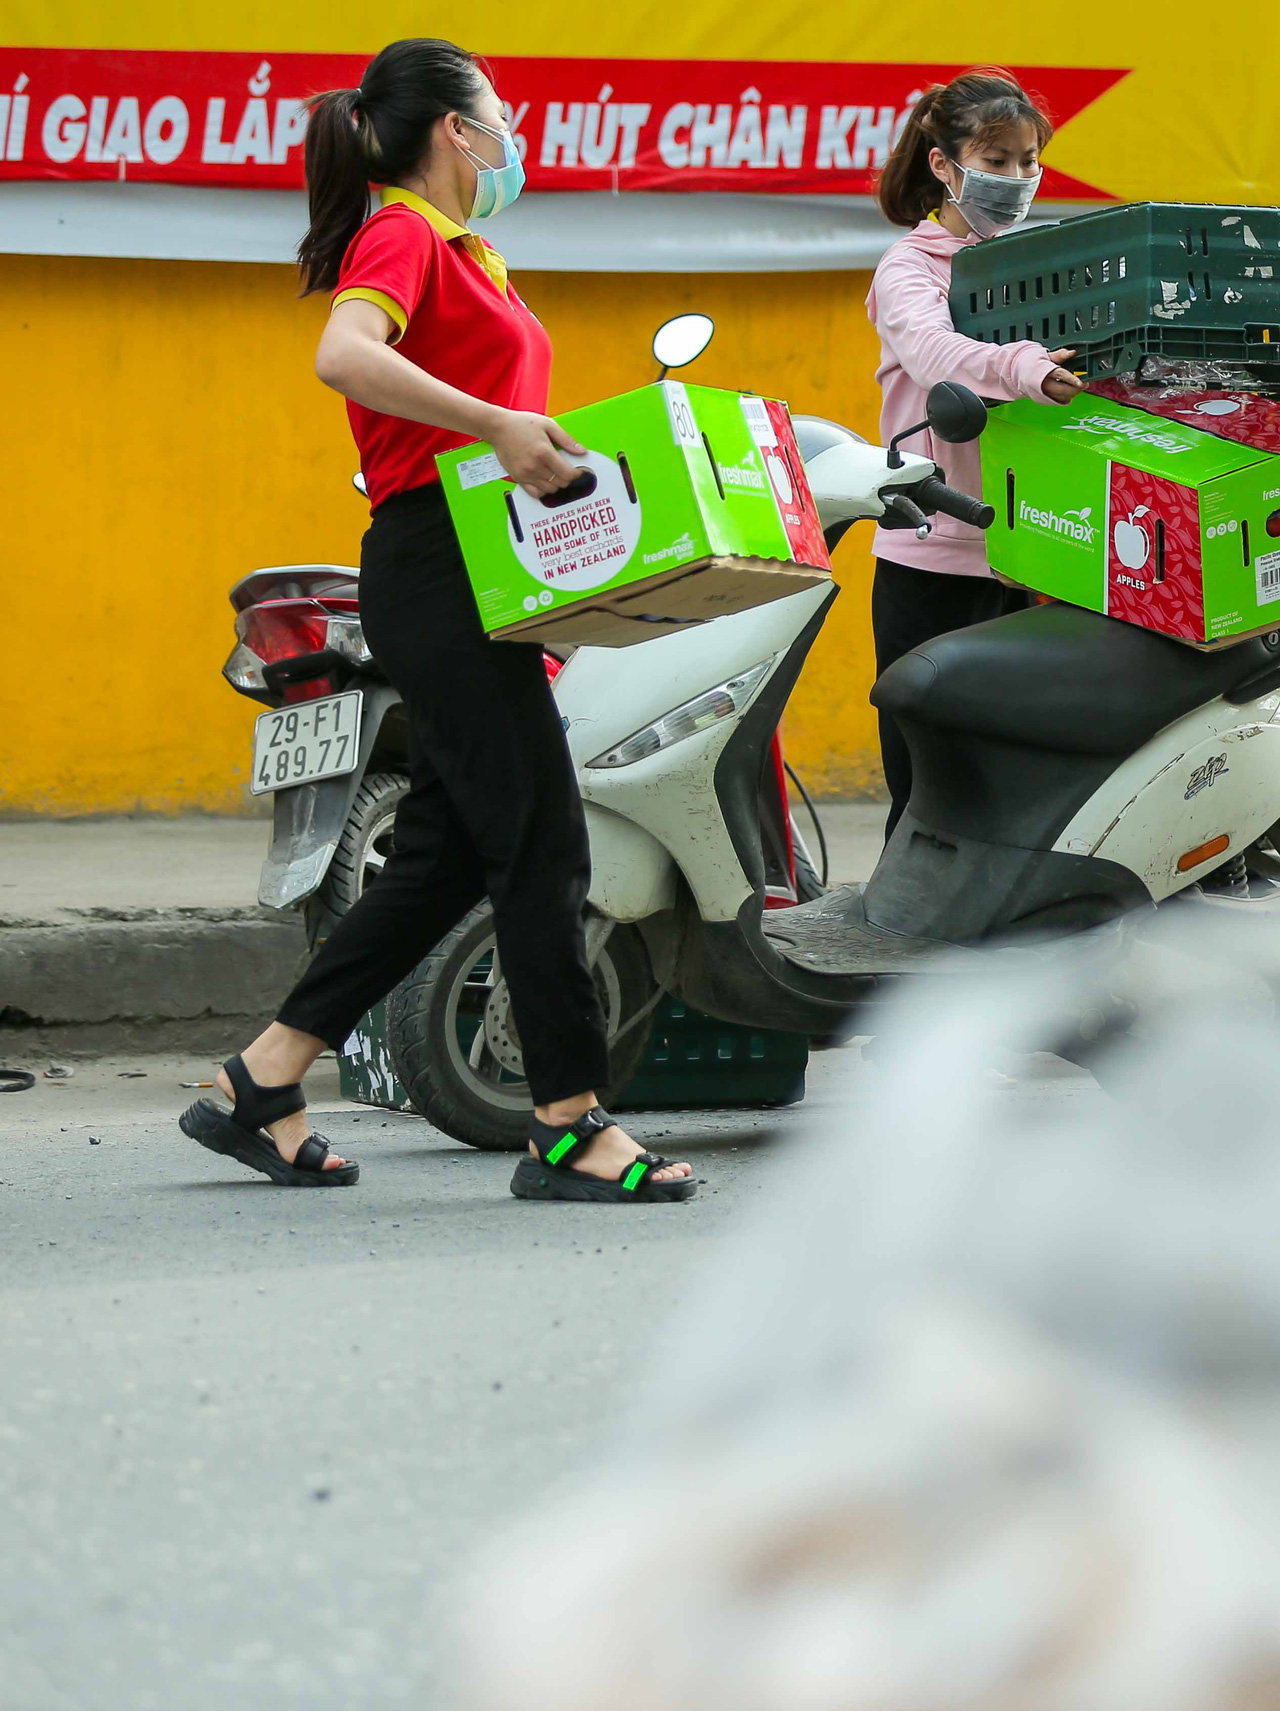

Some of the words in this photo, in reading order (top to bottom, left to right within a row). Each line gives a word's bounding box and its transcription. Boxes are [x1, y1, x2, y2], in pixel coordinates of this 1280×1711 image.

[41, 94, 189, 164] GIAO
[202, 61, 312, 165] LẮP
[539, 83, 651, 169] HÚT
[658, 86, 808, 169] CHÂN
[672, 401, 695, 439] 80
[530, 518, 550, 530] THESE
[552, 510, 576, 523] APPLES
[577, 504, 594, 514] HAVE
[595, 497, 611, 508] BEEN
[533, 506, 616, 548] HANDPICKED
[1019, 500, 1094, 544] freshmax
[538, 545, 562, 559] FROM
[563, 536, 588, 551] SOME
[590, 531, 600, 542] OF
[603, 524, 621, 537] THE
[541, 556, 561, 568] very
[563, 548, 583, 561] best
[584, 535, 624, 555] orchards
[643, 540, 695, 564] freshmax
[543, 569, 555, 580] IN
[557, 561, 578, 576] NEW
[580, 544, 627, 568] ZEALAND
[1116, 573, 1146, 591] APPLES
[269, 701, 342, 748] 29-F1
[258, 734, 349, 786] 489.77
